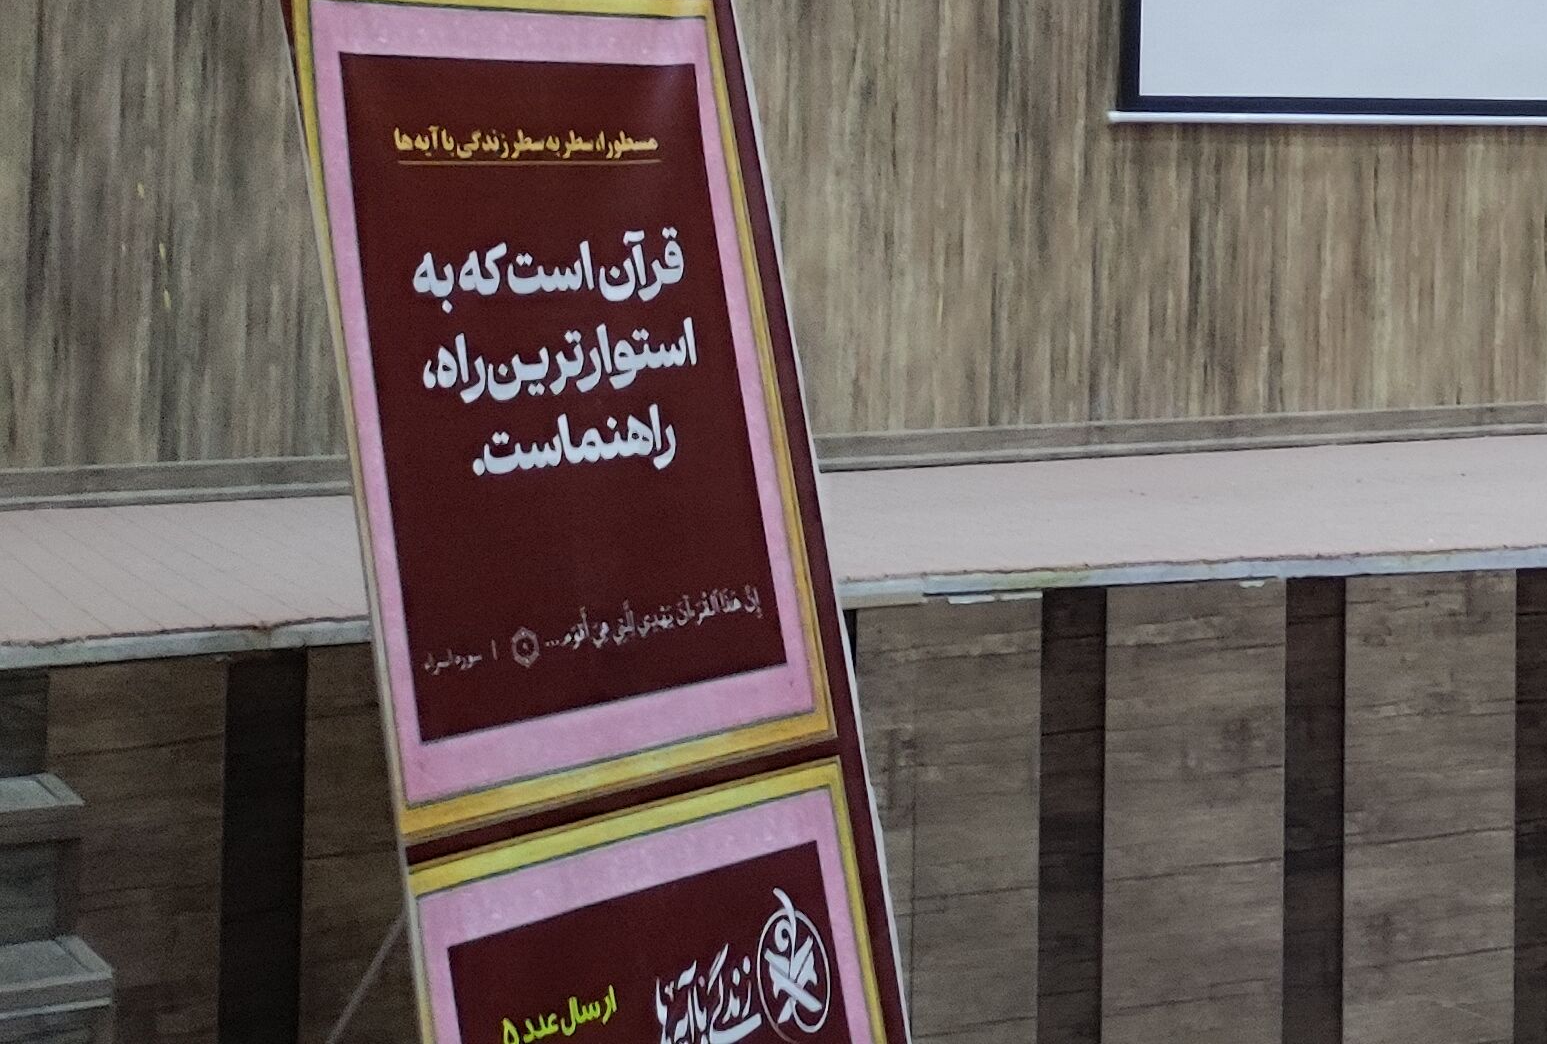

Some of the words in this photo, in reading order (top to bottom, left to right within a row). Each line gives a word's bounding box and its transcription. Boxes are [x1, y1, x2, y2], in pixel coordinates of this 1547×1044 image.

[412, 250, 455, 312] به
[458, 242, 506, 299] که
[507, 239, 594, 297] است
[598, 227, 685, 303] قرآن
[523, 1013, 559, 1044] عدد
[560, 984, 617, 1036] ارسال
